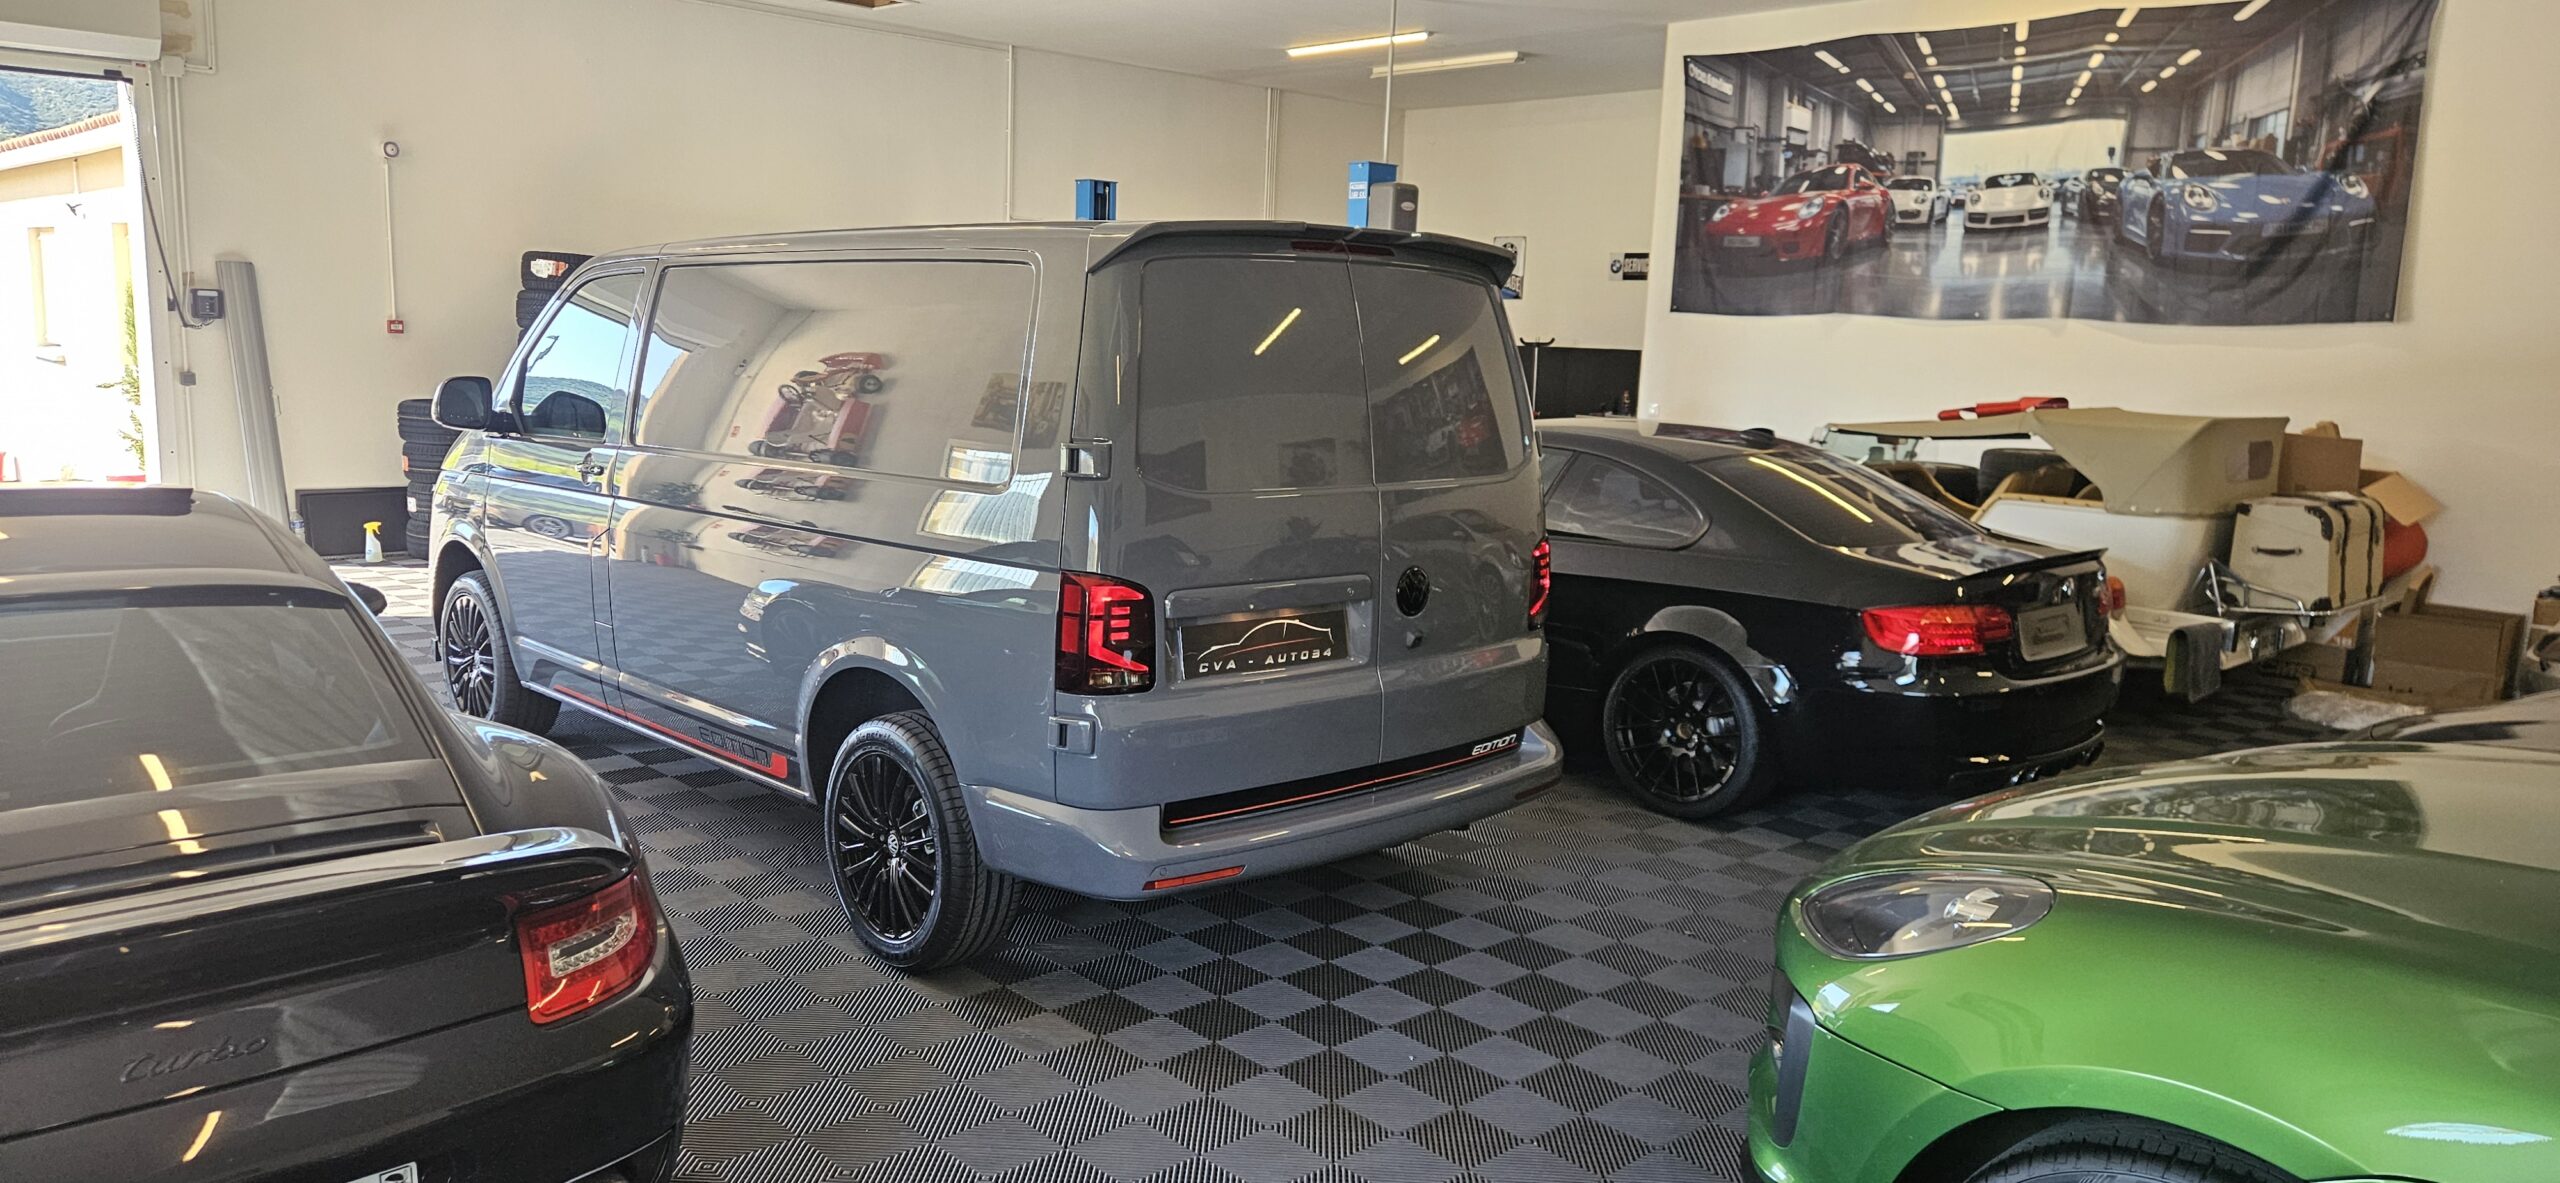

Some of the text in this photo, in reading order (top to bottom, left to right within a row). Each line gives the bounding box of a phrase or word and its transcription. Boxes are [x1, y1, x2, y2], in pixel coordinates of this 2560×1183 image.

[1199, 659, 1236, 673] CVA
[1265, 648, 1332, 665] AUTO34
[1472, 733, 1517, 756] EDITION
